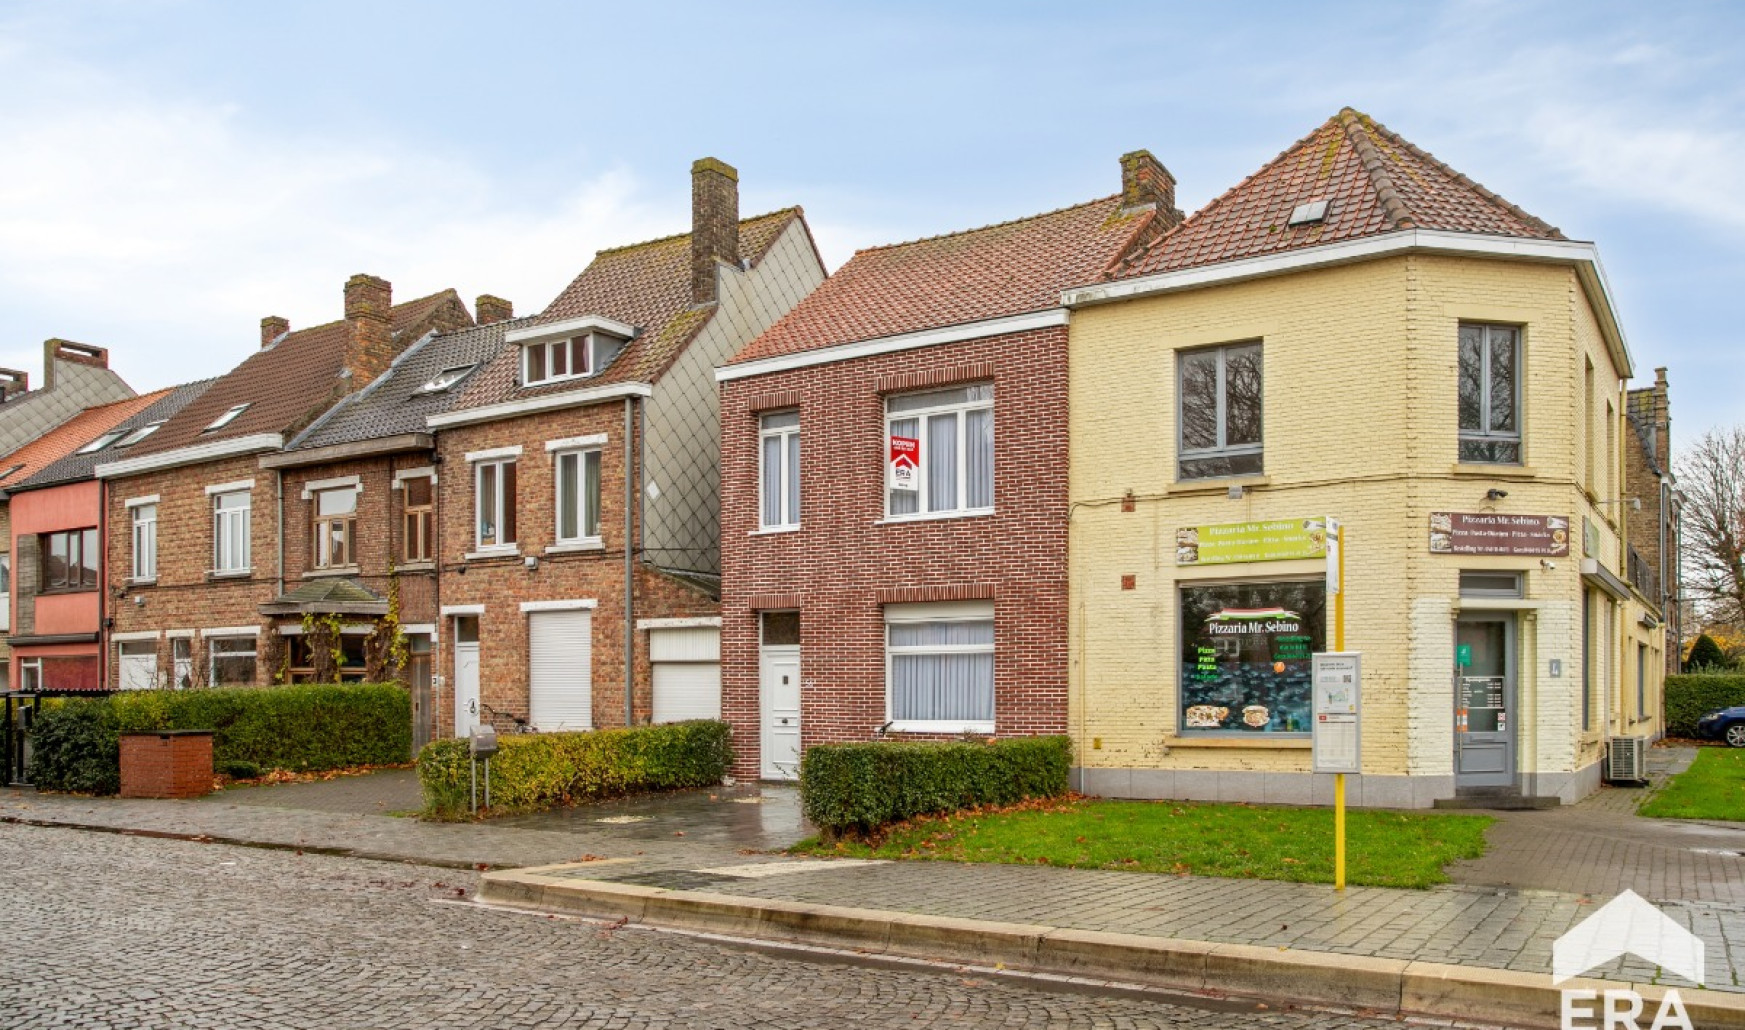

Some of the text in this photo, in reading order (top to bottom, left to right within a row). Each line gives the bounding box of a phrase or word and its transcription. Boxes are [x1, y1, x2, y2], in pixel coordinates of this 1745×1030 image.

[1463, 515, 1540, 525] Pizzaria Mr. Sebino
[1209, 527, 1246, 536] Pizzaria
[1263, 522, 1294, 531] Sebino
[1209, 620, 1299, 634] Pizzaria Mr. Sebino
